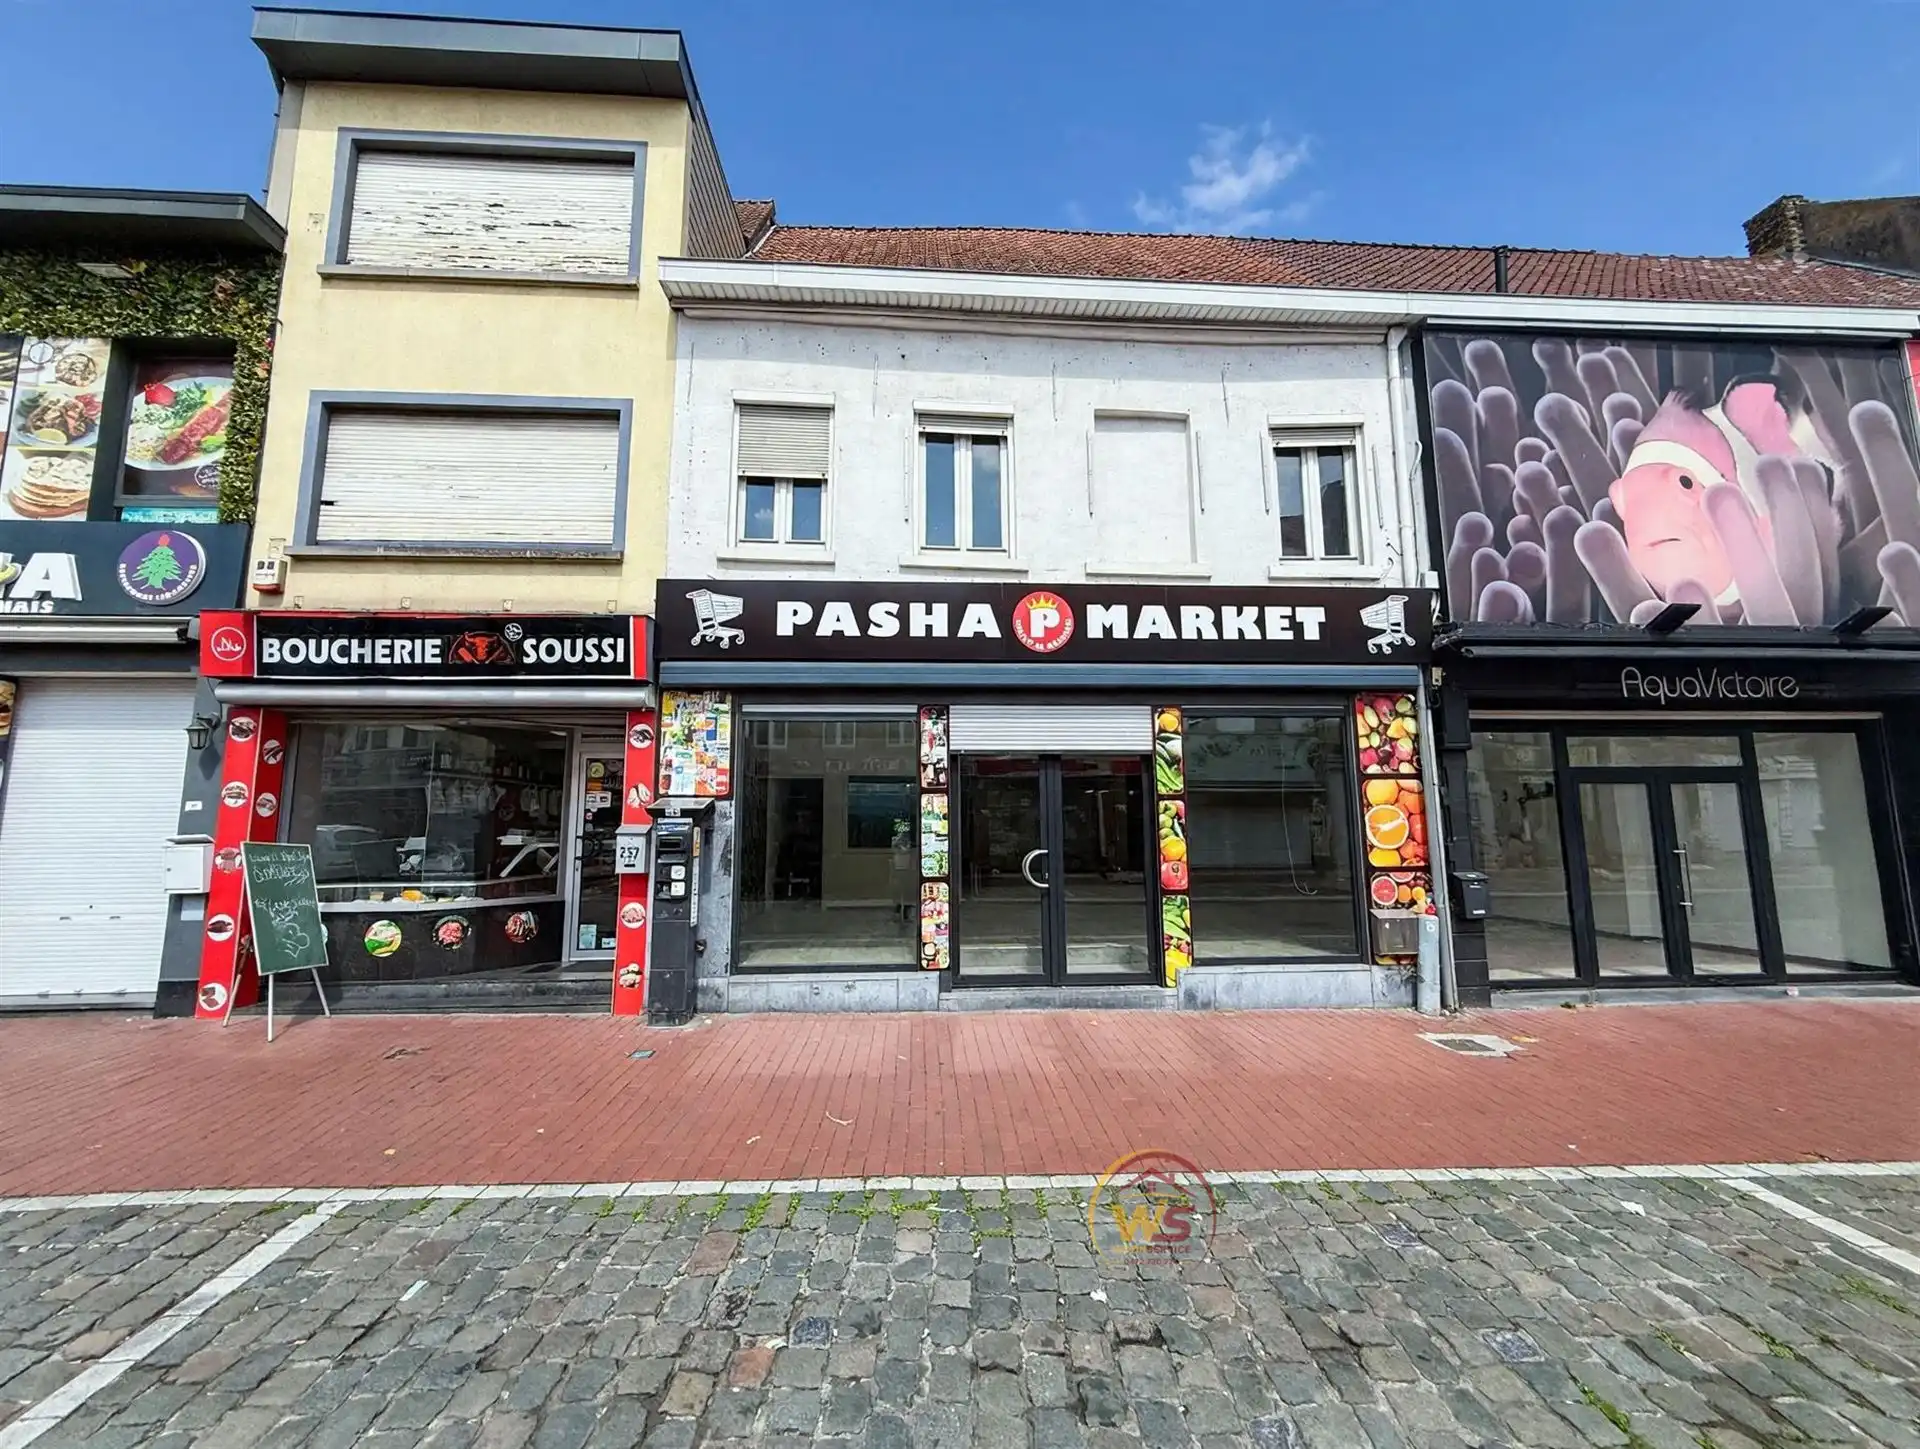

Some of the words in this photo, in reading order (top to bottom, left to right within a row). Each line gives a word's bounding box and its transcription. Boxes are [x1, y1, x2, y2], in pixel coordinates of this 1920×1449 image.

[776, 601, 1002, 638] PASHA
[1086, 604, 1326, 640] MARKET
[1030, 607, 1060, 638] P
[262, 637, 442, 664] BOUCHERIE
[522, 637, 625, 664] SOUSSI
[1621, 666, 1800, 705] AquaVictoire
[619, 846, 640, 860] 257
